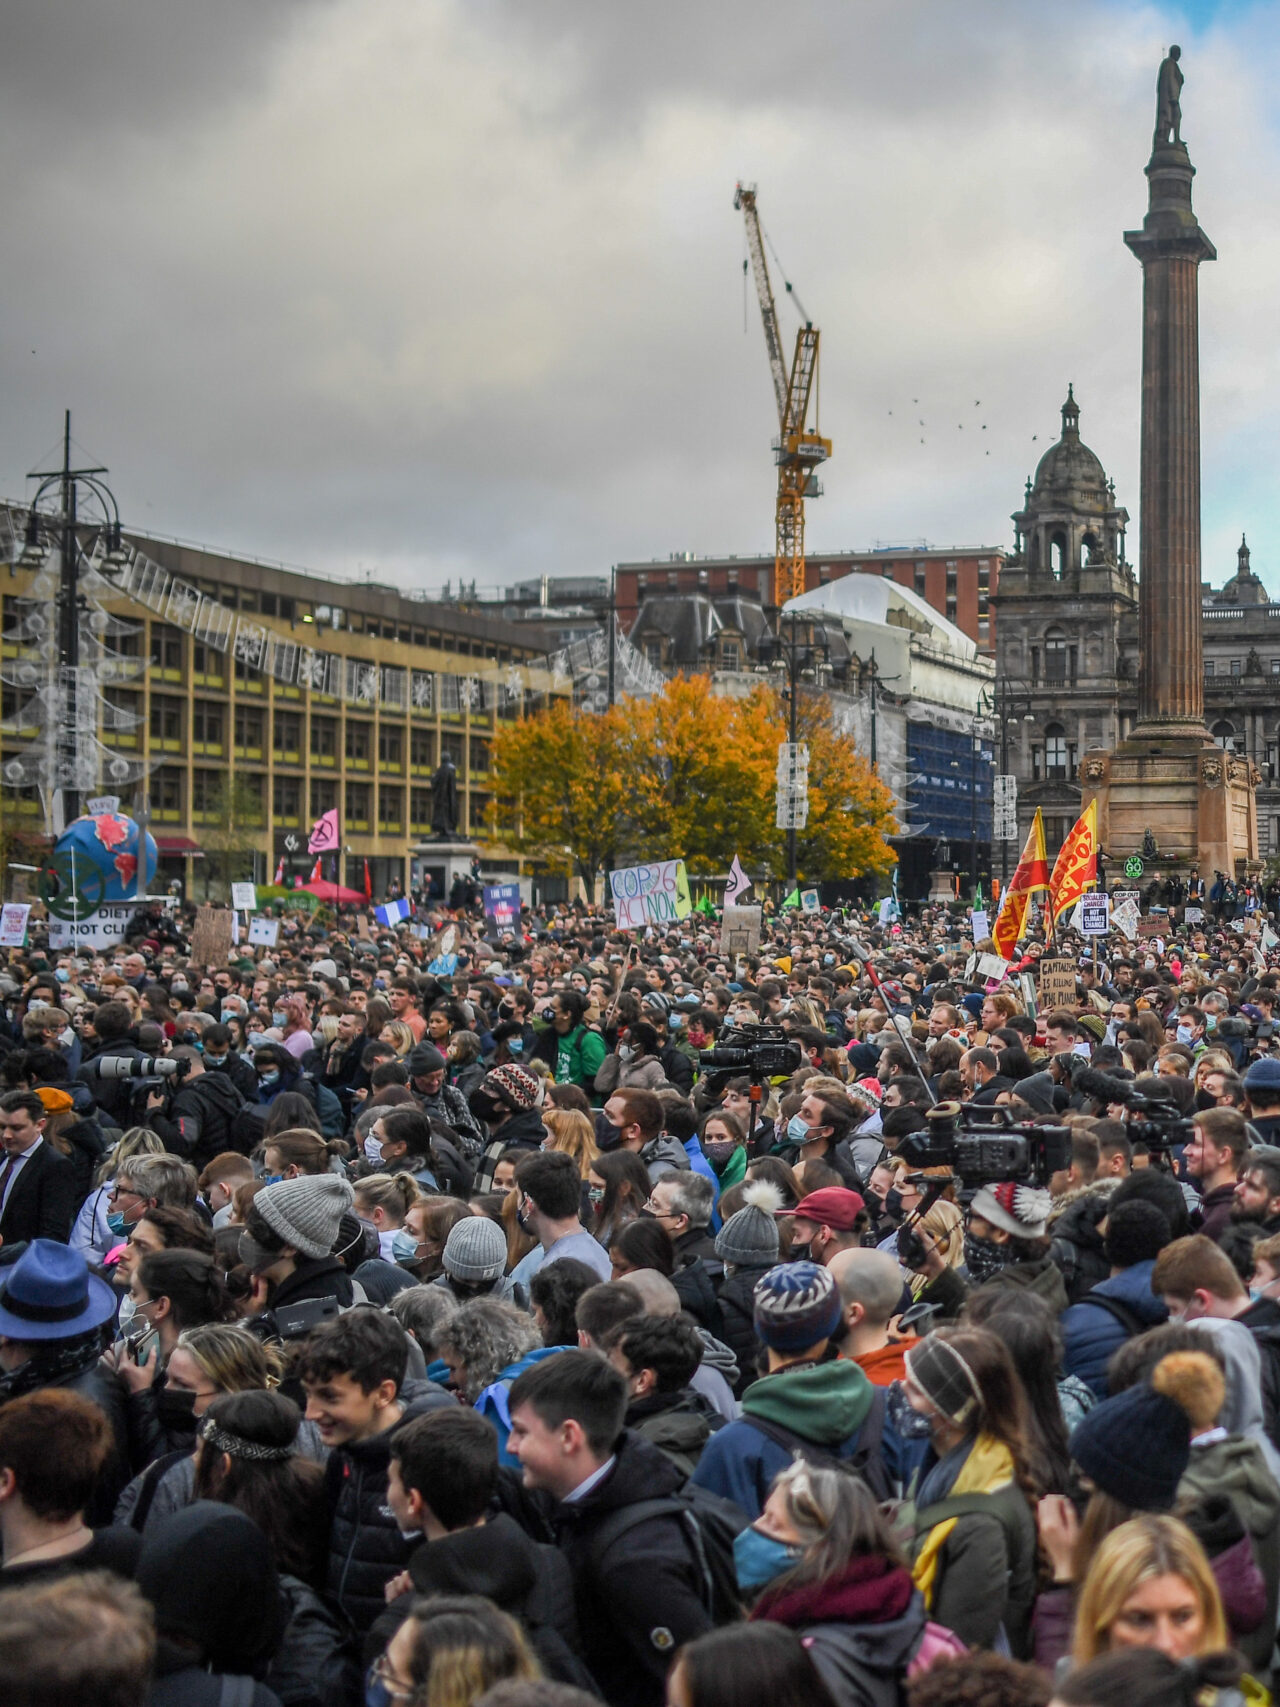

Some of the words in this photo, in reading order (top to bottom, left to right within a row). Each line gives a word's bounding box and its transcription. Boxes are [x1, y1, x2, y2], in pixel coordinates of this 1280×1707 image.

[1126, 862, 1141, 872] GO
[612, 862, 676, 899] COP26
[98, 908, 131, 919] DIET
[618, 894, 647, 926] ACT
[646, 891, 678, 921] NOW
[69, 924, 98, 935] NOT
[1042, 961, 1076, 975] CAPITALISM
[1043, 978, 1050, 989] IS
[1053, 978, 1073, 987] KILLING
[1042, 992, 1056, 1007] THE
